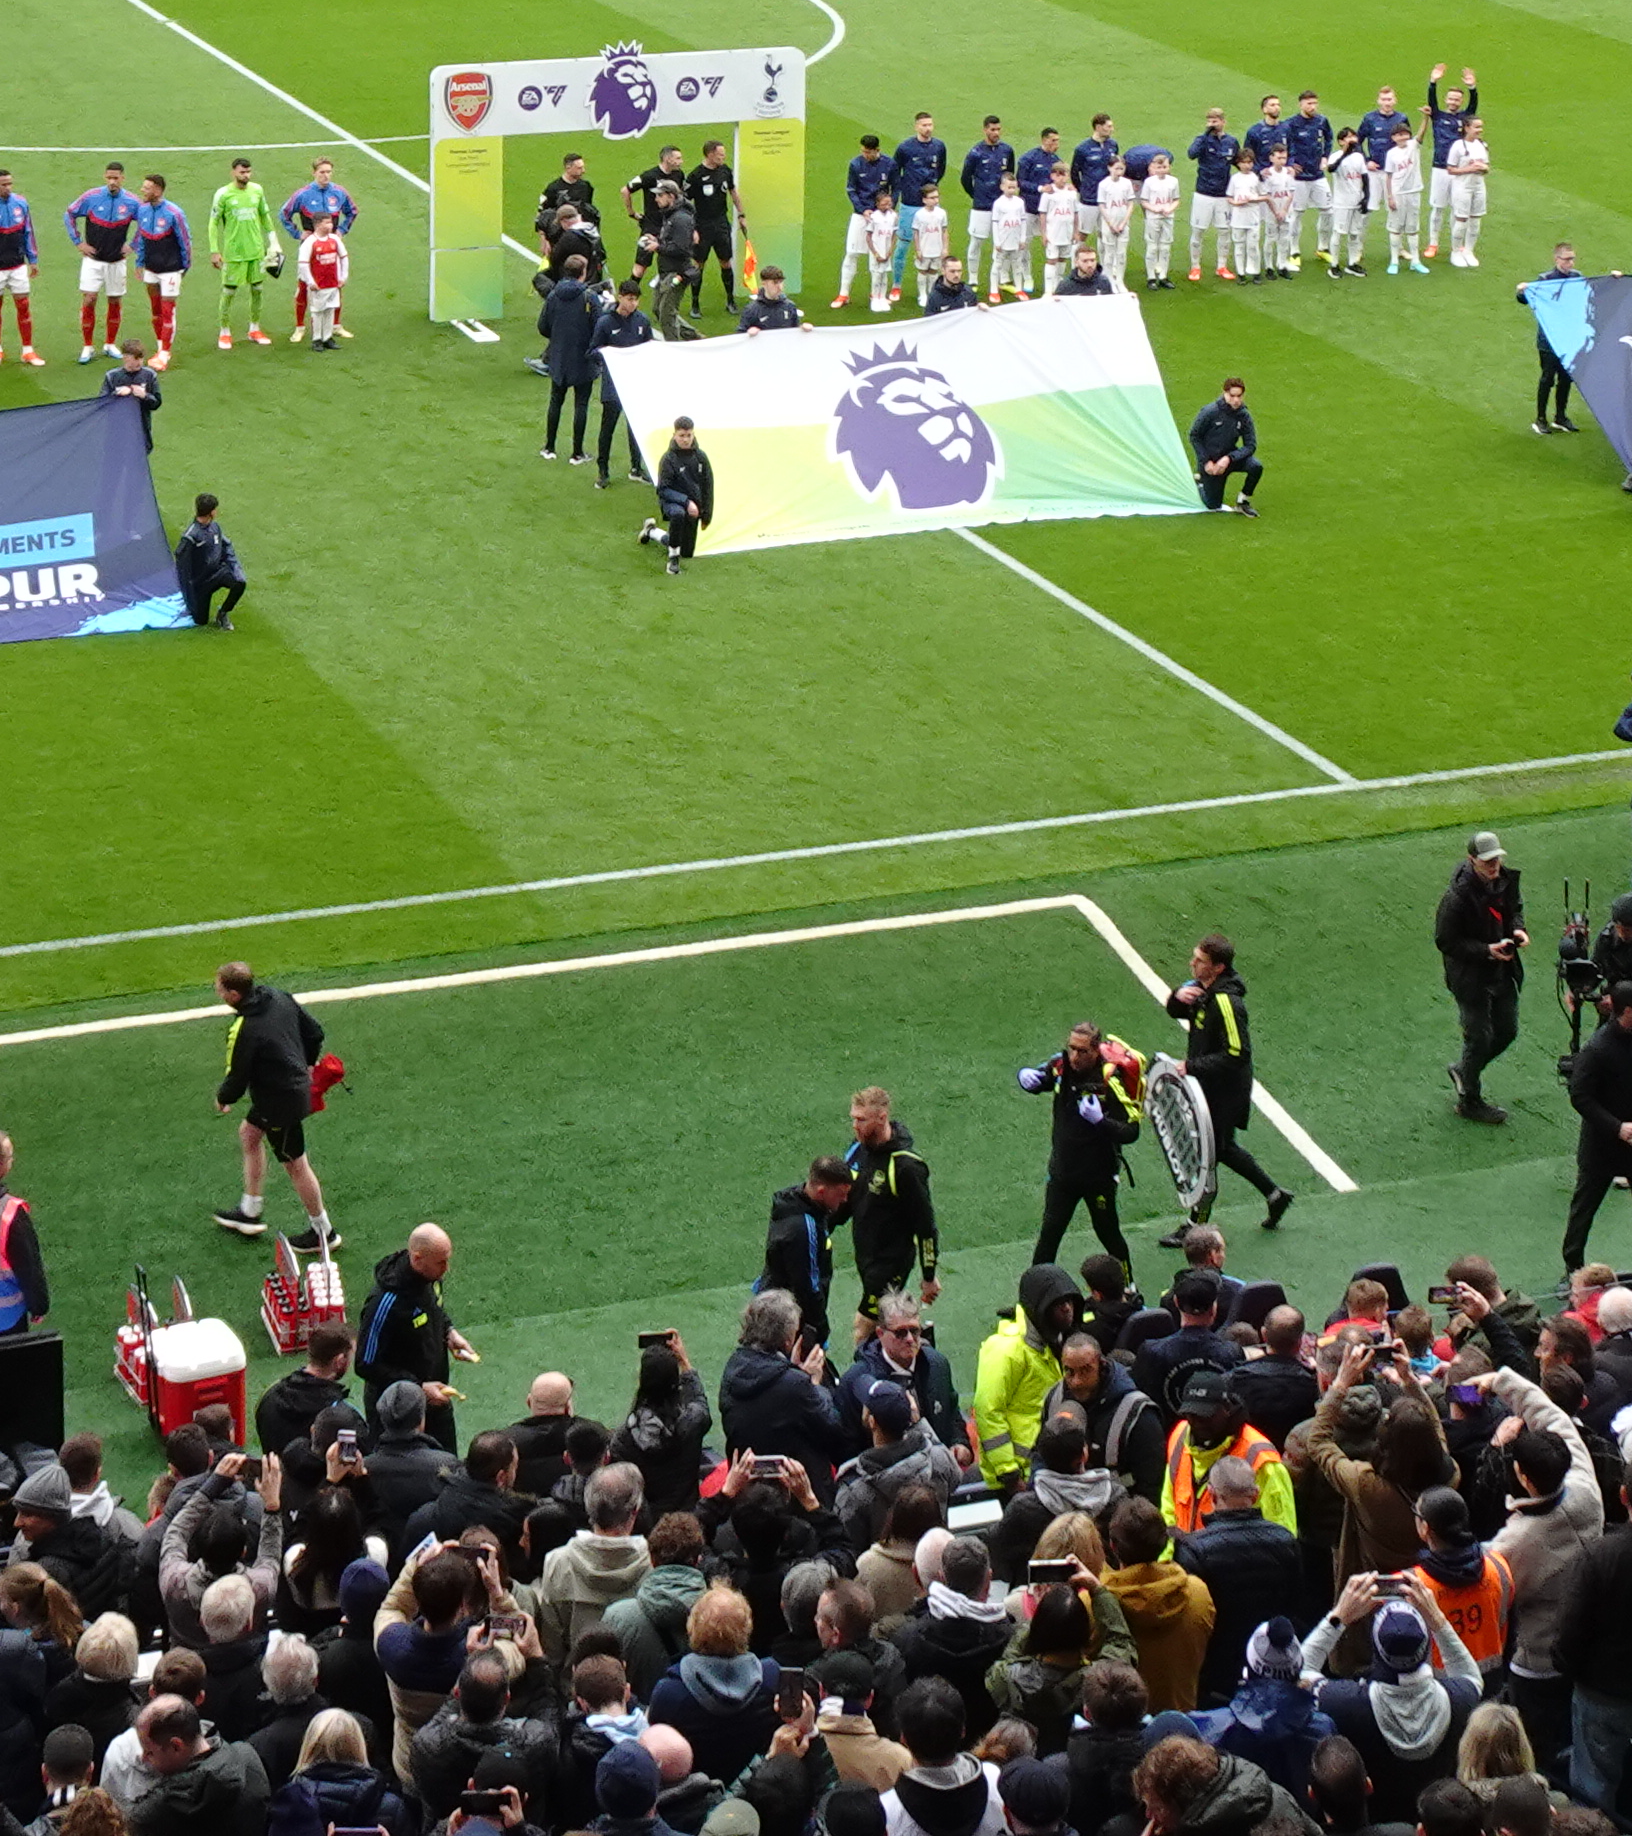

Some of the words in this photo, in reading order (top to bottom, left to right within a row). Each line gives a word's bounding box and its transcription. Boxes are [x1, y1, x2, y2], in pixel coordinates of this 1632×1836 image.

[451, 80, 487, 92] Arsenal
[1054, 207, 1071, 215] AIA
[1003, 219, 1020, 228] AIA
